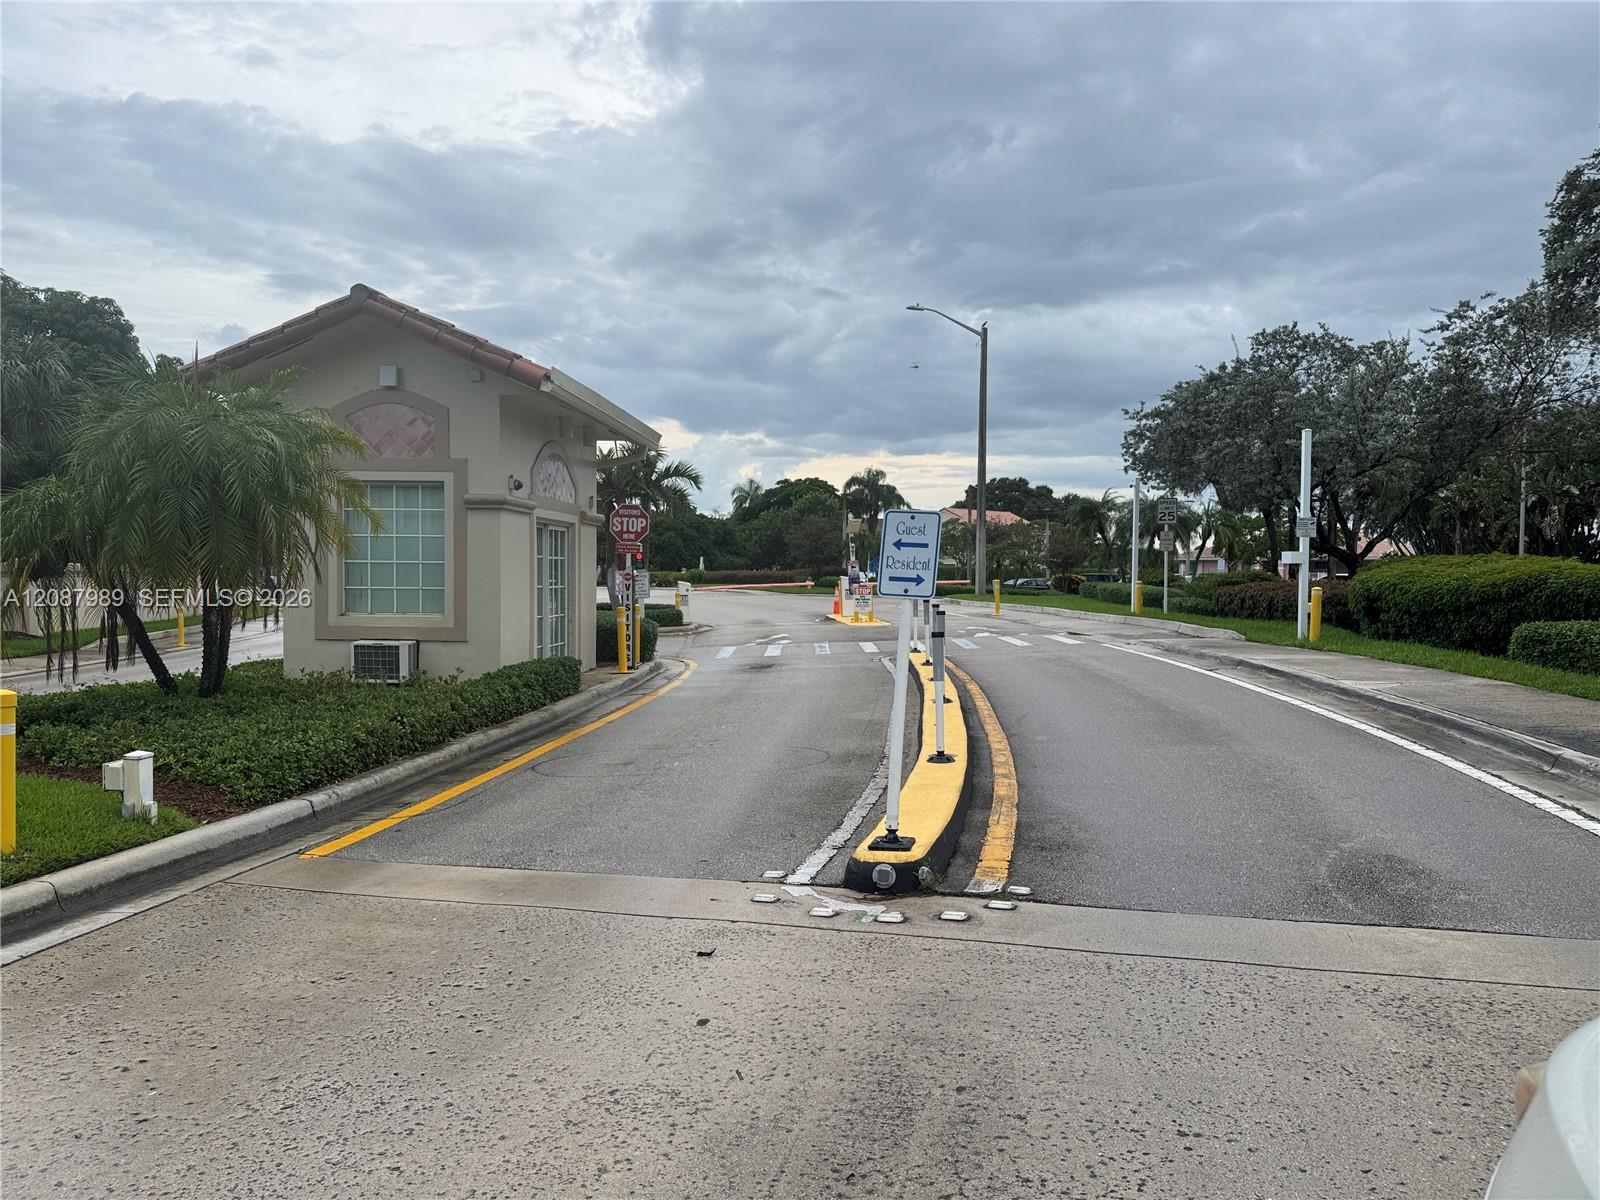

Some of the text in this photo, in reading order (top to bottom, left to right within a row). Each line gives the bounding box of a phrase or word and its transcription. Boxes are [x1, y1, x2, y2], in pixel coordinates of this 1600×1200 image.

[612, 516, 646, 532] STOP
[1158, 512, 1176, 521] 25
[896, 521, 927, 536] Guest
[886, 555, 931, 571] Resident
